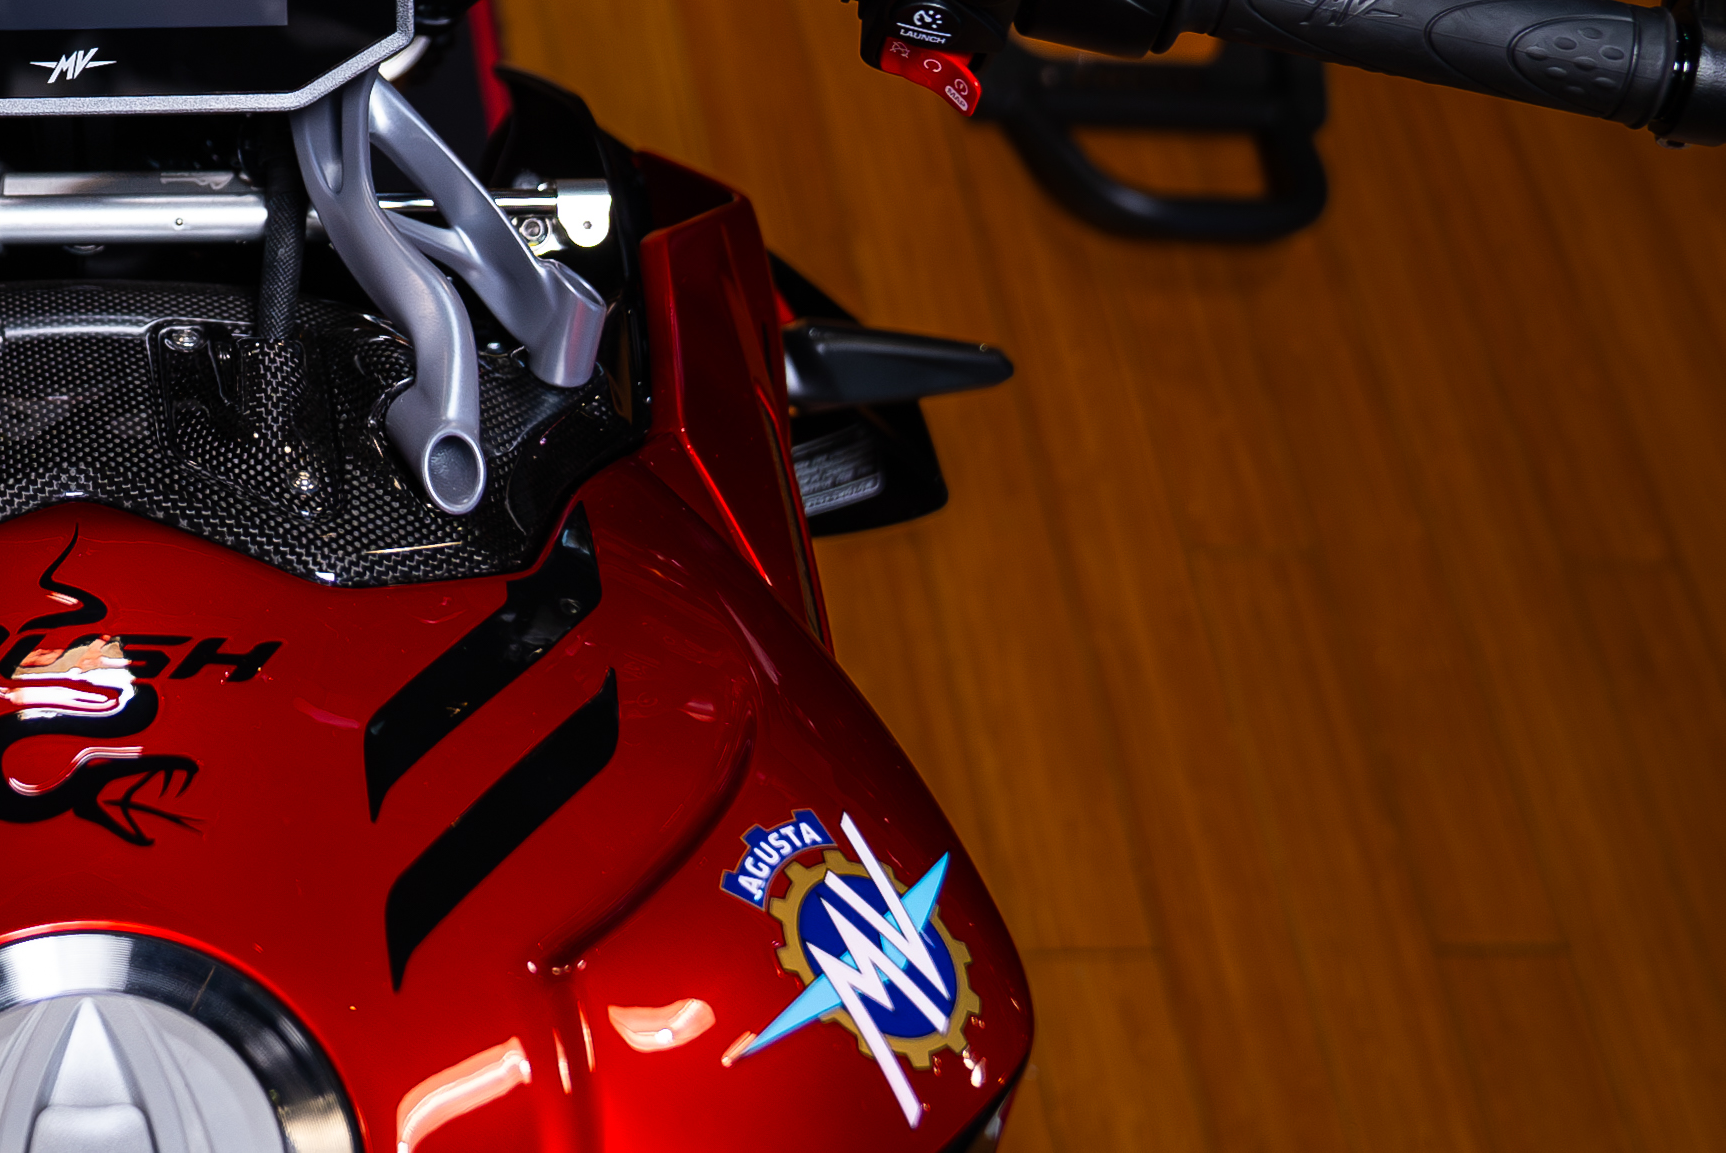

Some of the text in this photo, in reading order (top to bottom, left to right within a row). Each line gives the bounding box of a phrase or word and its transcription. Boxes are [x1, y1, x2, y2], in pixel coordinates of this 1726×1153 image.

[899, 28, 947, 44] LAUNCH
[46, 47, 100, 84] MV
[946, 86, 967, 108] MAP
[737, 821, 824, 902] AGUSTA
